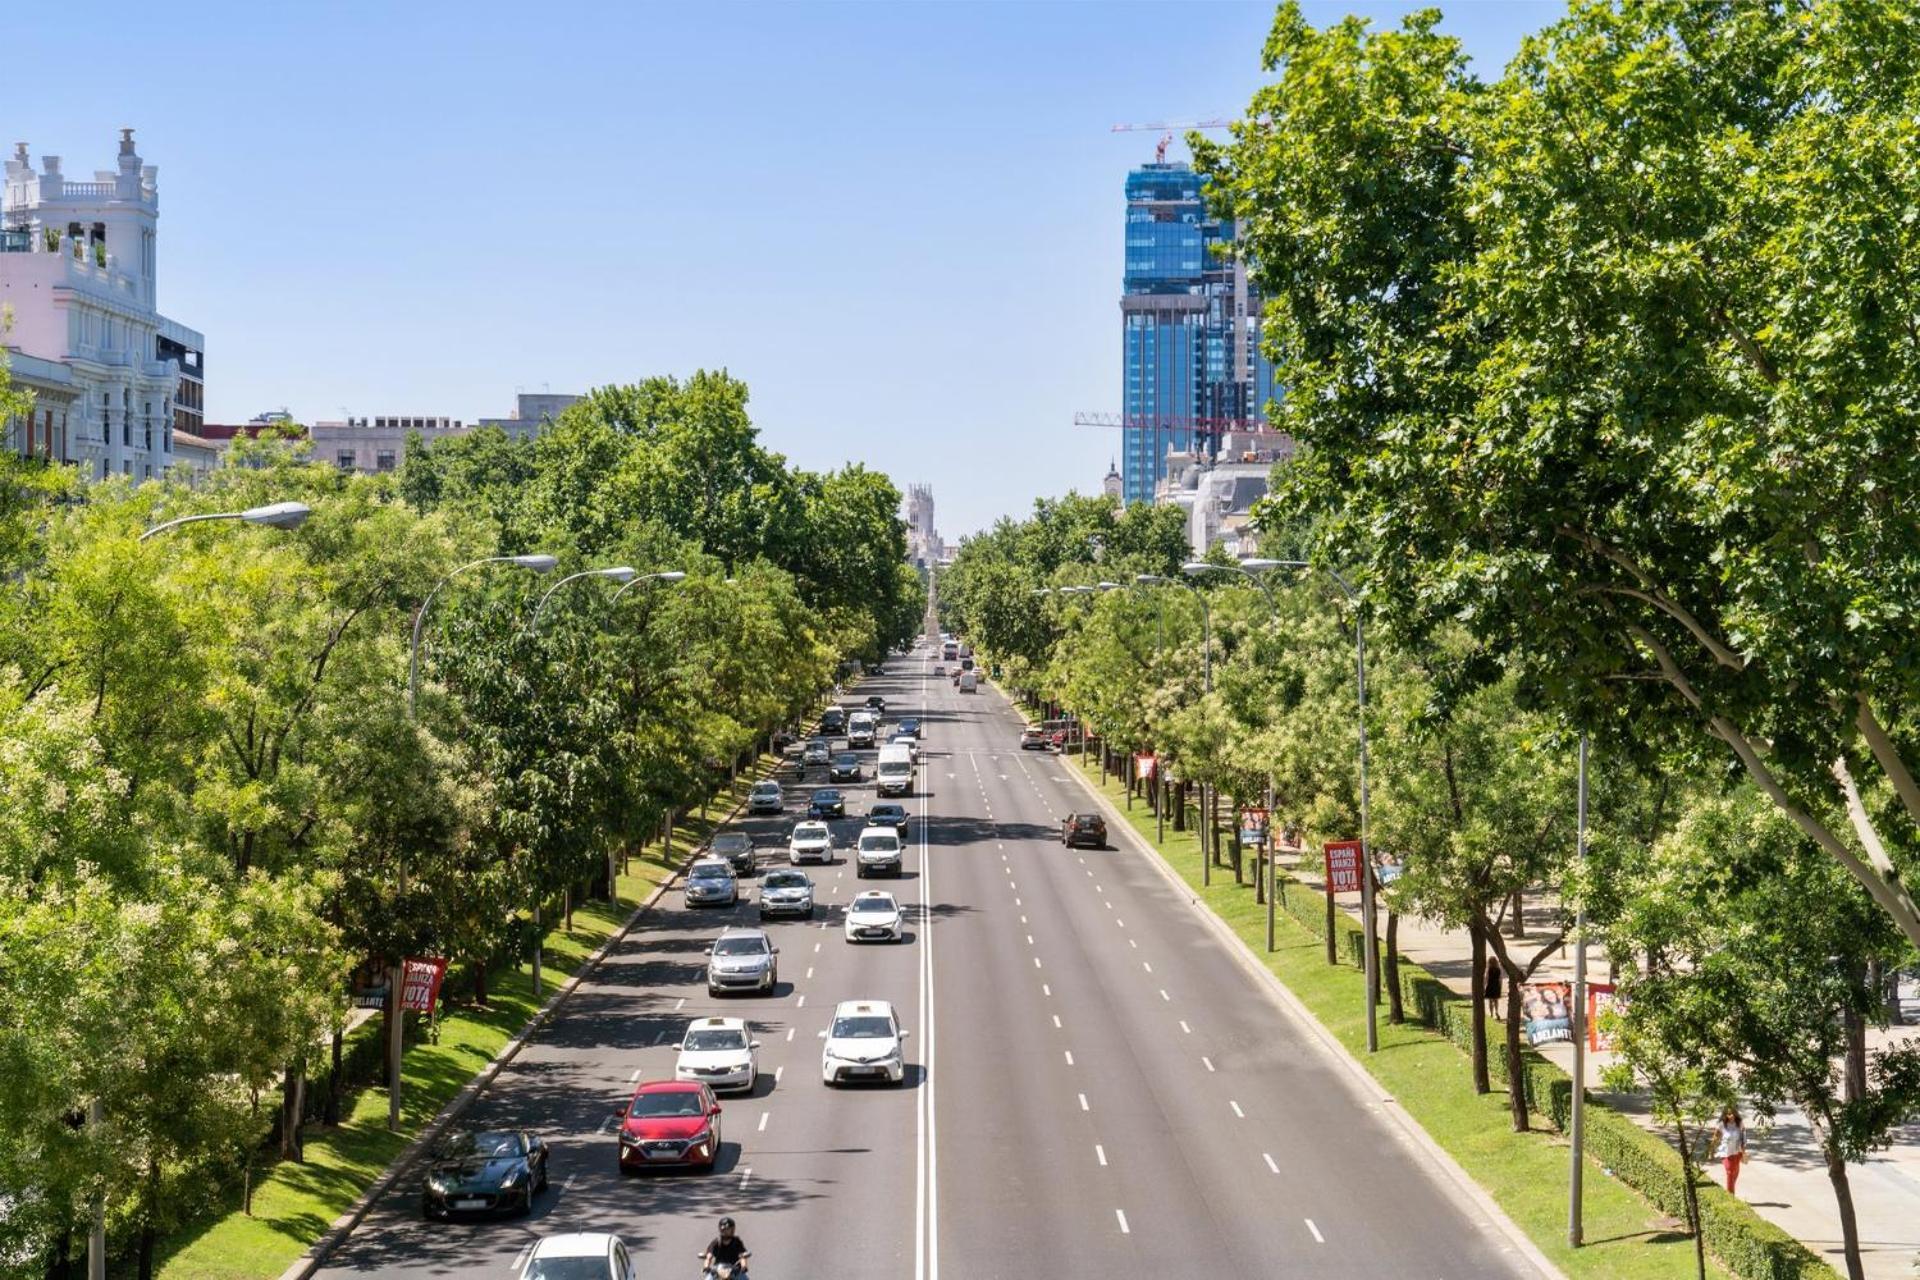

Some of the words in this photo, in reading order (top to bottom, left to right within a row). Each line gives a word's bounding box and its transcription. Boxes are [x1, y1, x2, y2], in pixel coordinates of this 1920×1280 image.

[1330, 847, 1356, 859] ESPAÑA
[1331, 858, 1356, 869] AVANZA
[1331, 870, 1357, 885] VOTA
[403, 986, 430, 1002] VOTA
